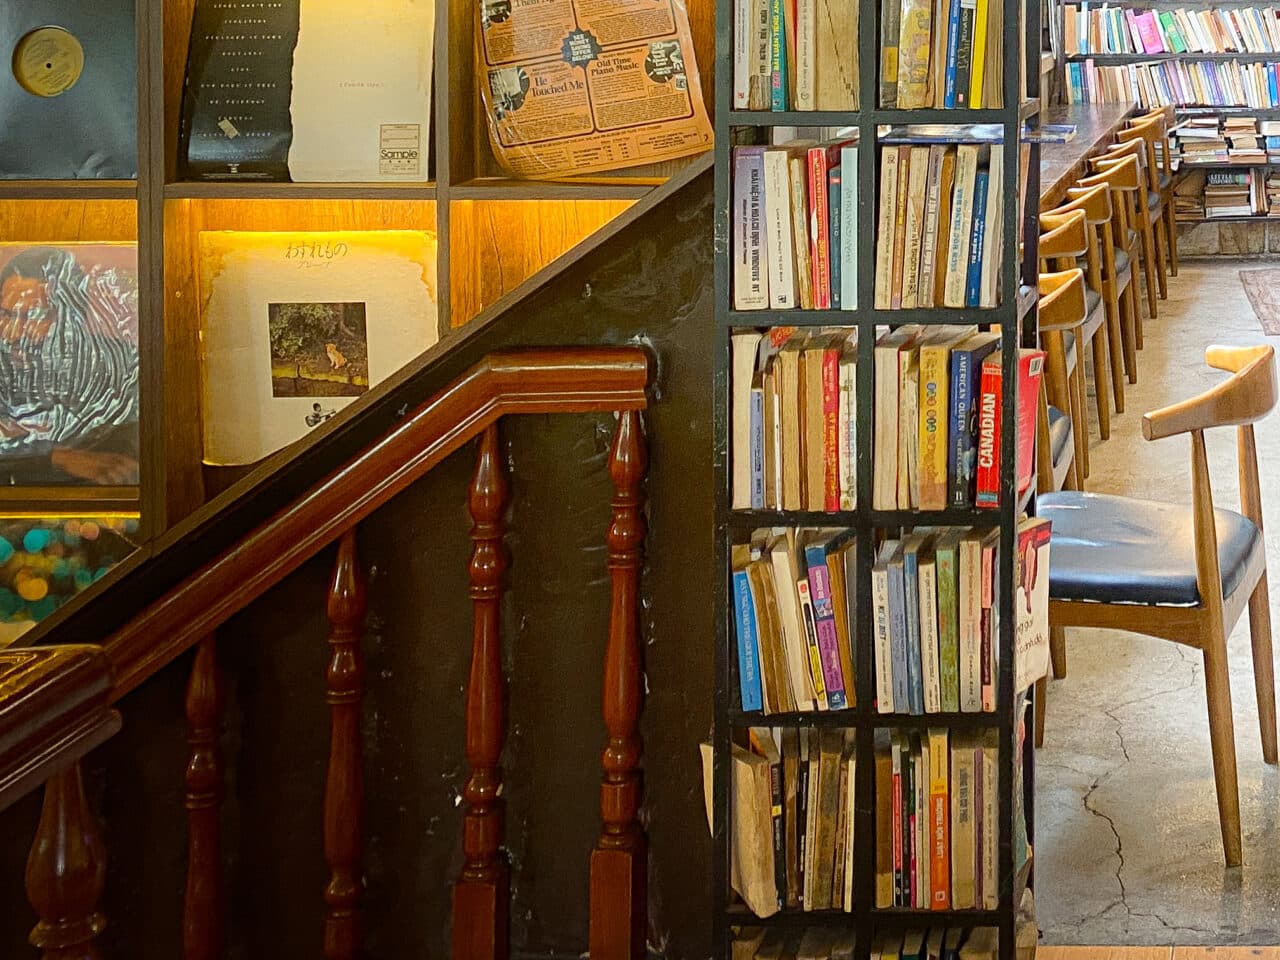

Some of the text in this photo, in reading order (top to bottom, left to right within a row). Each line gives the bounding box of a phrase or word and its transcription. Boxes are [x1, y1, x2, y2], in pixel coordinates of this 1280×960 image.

[569, 38, 589, 46] MONEY
[571, 48, 592, 57] OFFER
[591, 62, 640, 76] Piano Music
[596, 56, 632, 68] Old Time
[531, 80, 584, 97] Touched Me
[534, 77, 548, 86] He
[381, 149, 418, 159] Sample
[751, 168, 761, 184] KHÁI
[750, 208, 760, 230] HOẠCH
[749, 231, 760, 246] ĐỊNH
[285, 240, 348, 259] わすれもの
[752, 249, 760, 282] WINDOWS
[752, 283, 760, 293] NT
[957, 355, 967, 431] AMERICAN QUEEN
[980, 393, 996, 469] CANADIAN
